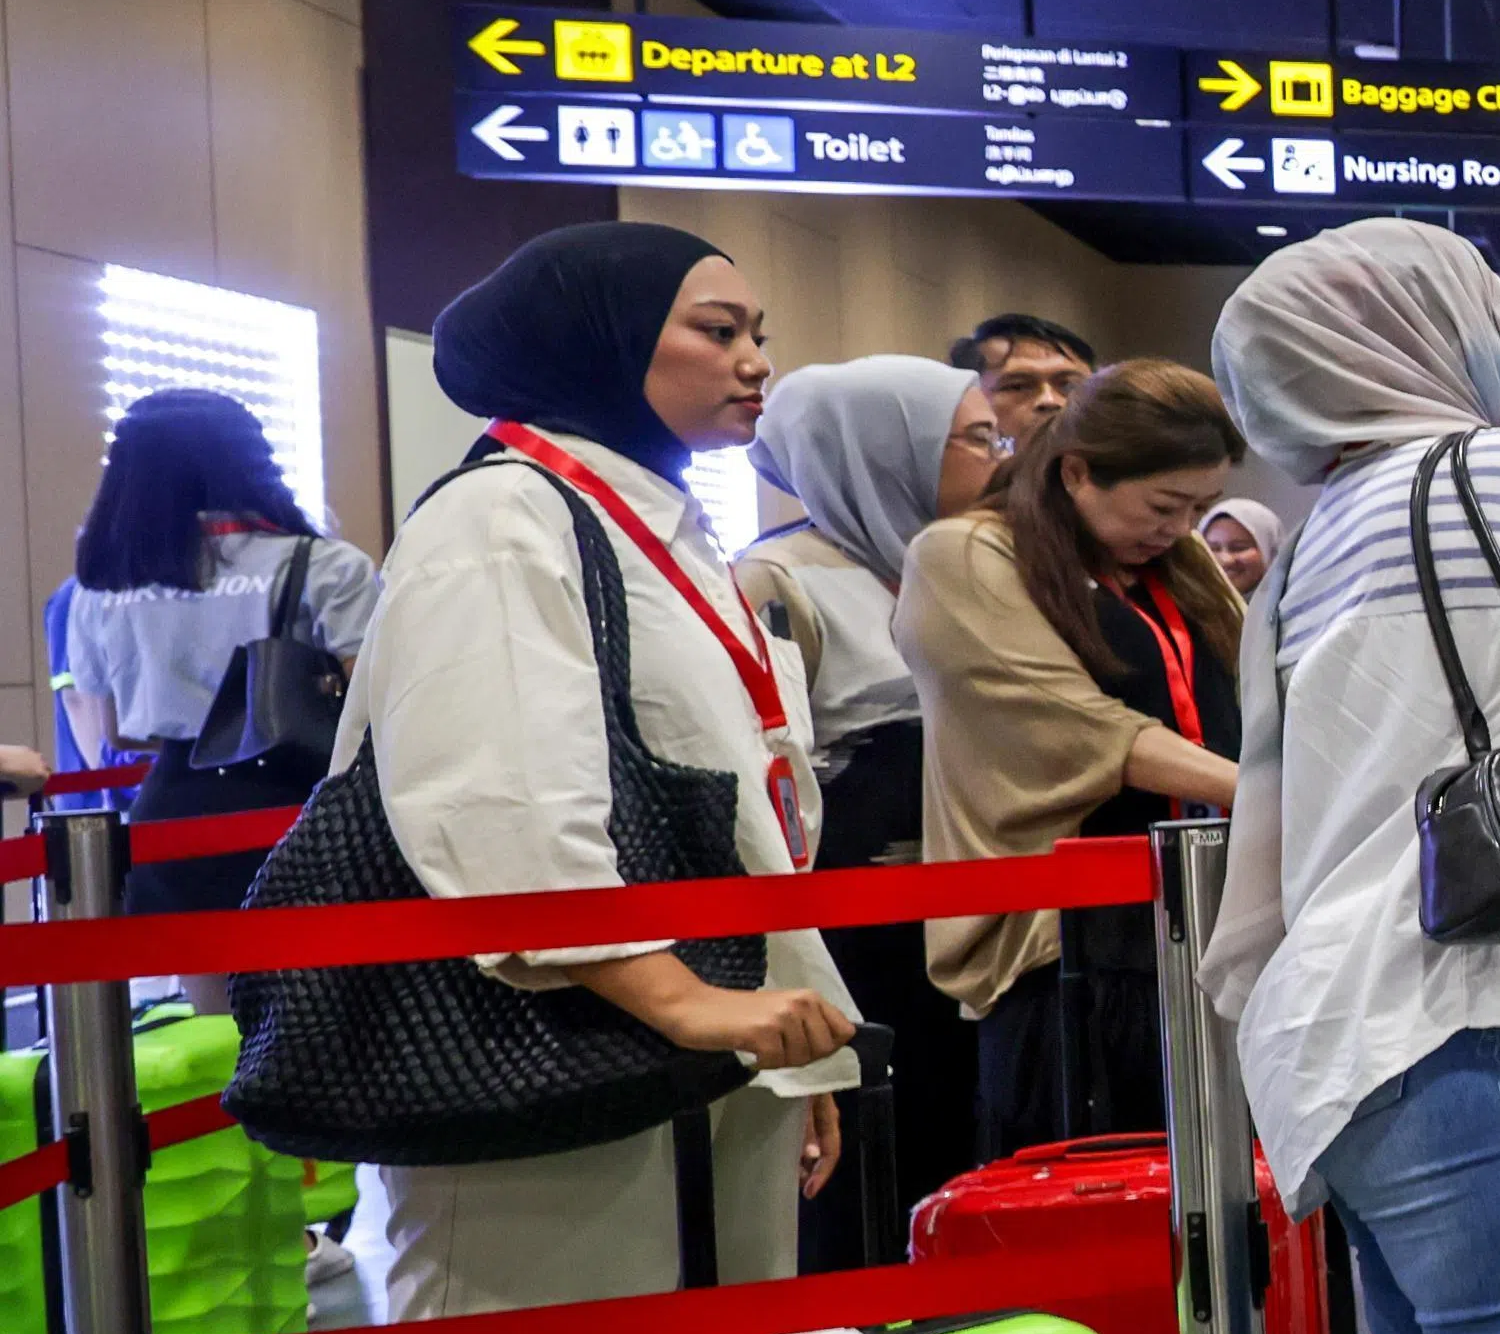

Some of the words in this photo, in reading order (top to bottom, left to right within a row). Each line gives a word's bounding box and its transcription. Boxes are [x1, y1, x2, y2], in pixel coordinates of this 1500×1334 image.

[641, 40, 824, 78] Departure
[831, 53, 869, 79] at
[876, 53, 917, 82] L2
[1342, 78, 1471, 114] Baggage
[805, 132, 905, 163] Toilet
[1343, 155, 1456, 190] Nursing
